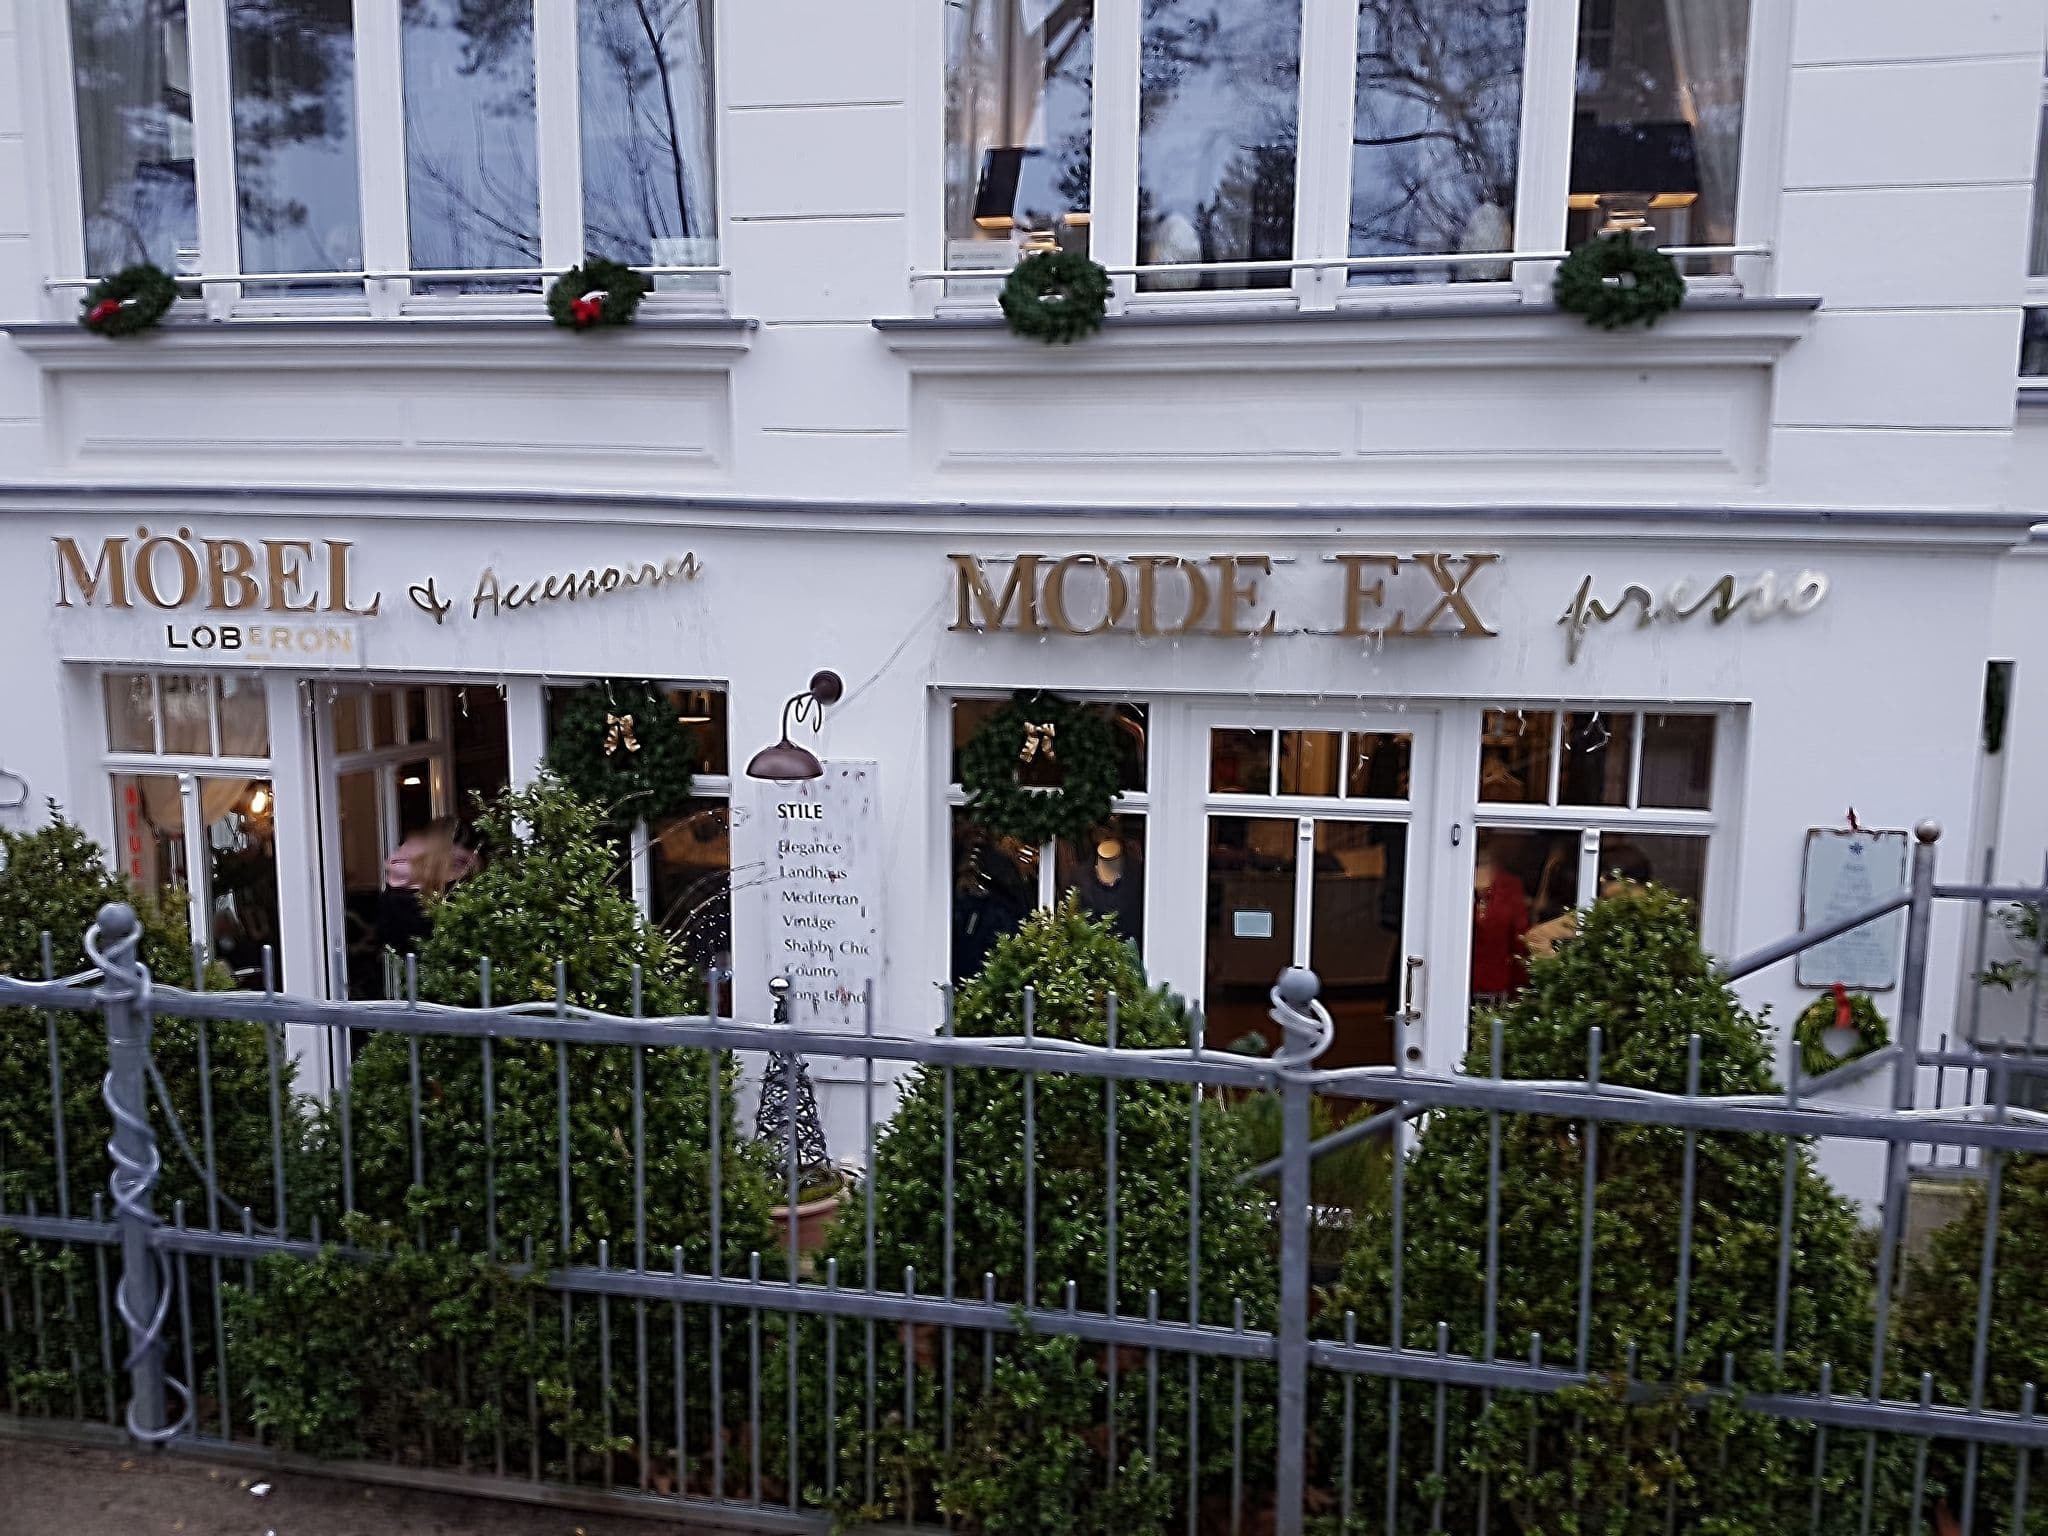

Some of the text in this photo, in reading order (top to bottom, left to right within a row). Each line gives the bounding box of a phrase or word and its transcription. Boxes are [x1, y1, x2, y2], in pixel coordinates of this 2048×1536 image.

[50, 525, 382, 617] MÖBEL
[472, 551, 704, 620] Accessoires
[946, 553, 1278, 637] MODE
[1334, 553, 1501, 637] EX
[166, 624, 352, 652] LOBERON
[777, 803, 823, 819] STILE
[778, 839, 842, 857] Elegance
[779, 864, 848, 880] Landhaus
[783, 914, 836, 932] Vintage
[784, 939, 870, 957] Shabby Chic
[784, 962, 839, 978] Country
[793, 990, 820, 1006] ong
